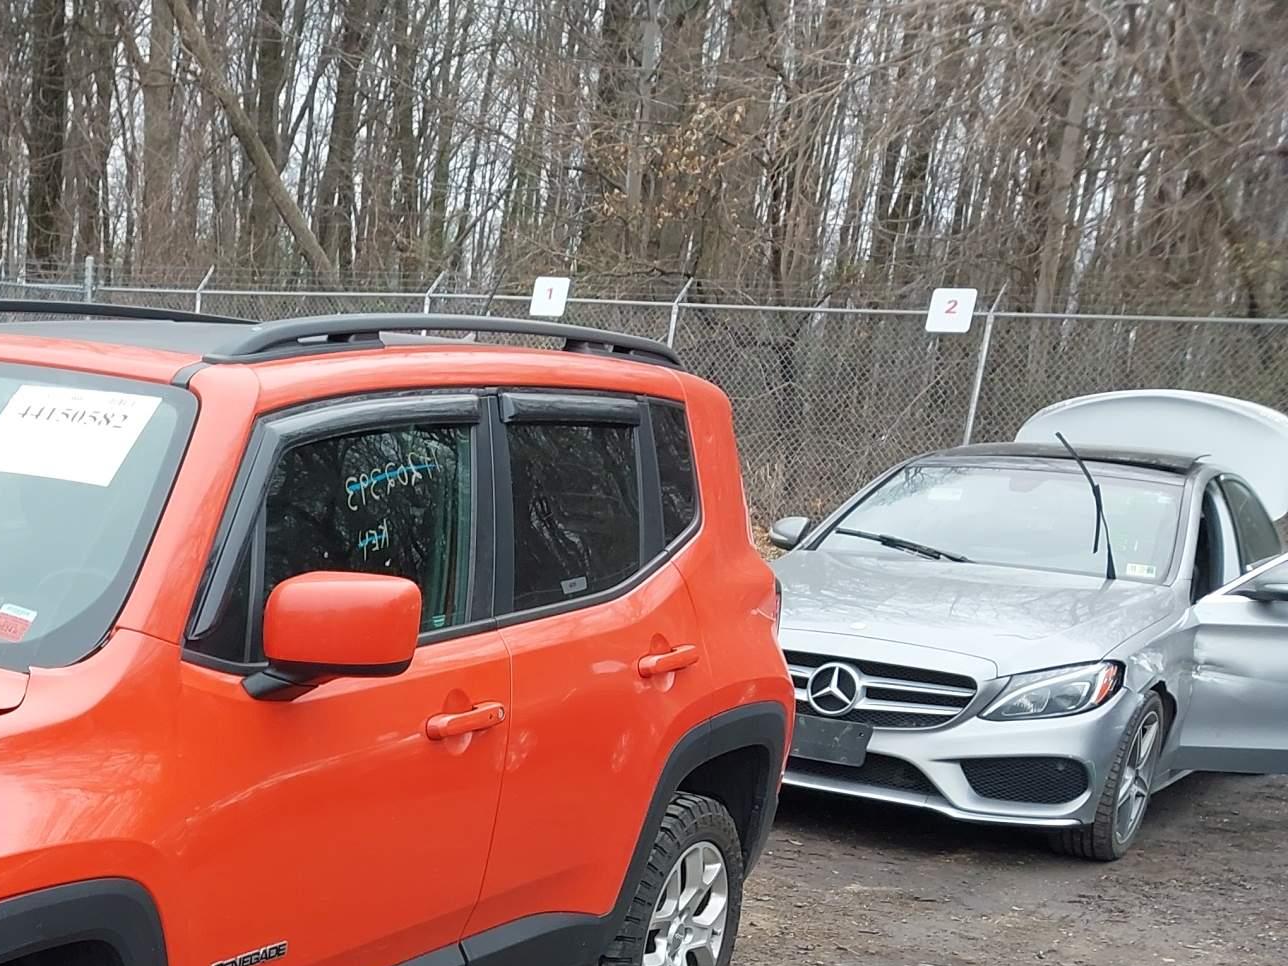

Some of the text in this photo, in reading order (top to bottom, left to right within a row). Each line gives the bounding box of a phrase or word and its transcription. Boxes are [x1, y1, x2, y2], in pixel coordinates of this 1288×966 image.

[546, 287, 553, 300] 1
[944, 299, 958, 314] 2
[18, 405, 128, 429] 44150582
